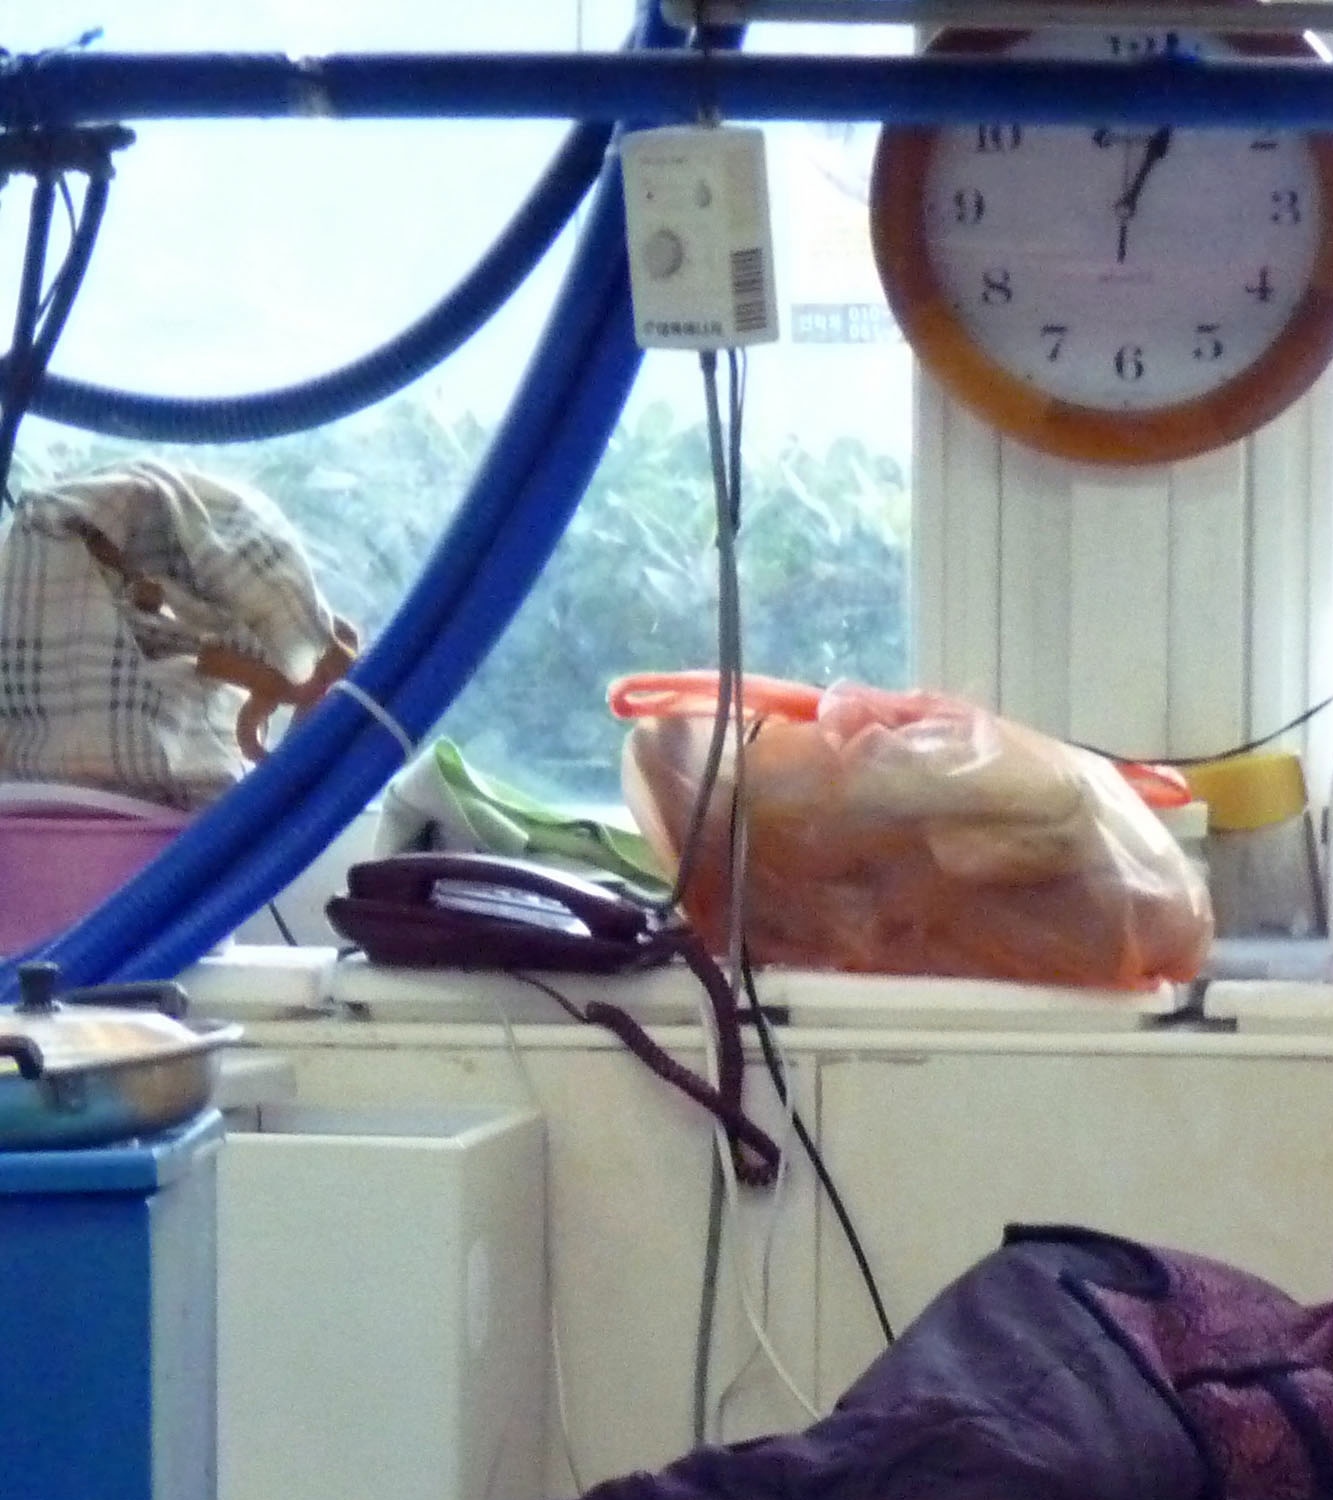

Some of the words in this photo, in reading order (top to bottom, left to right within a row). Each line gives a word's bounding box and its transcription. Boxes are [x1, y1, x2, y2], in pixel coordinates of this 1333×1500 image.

[954, 187, 985, 225] 9
[1271, 189, 1301, 225] 3
[981, 270, 1013, 303] 8
[1245, 266, 1275, 303] 4
[1040, 325, 1068, 362] 7
[1193, 324, 1224, 361] 5
[1114, 346, 1145, 382] 6
